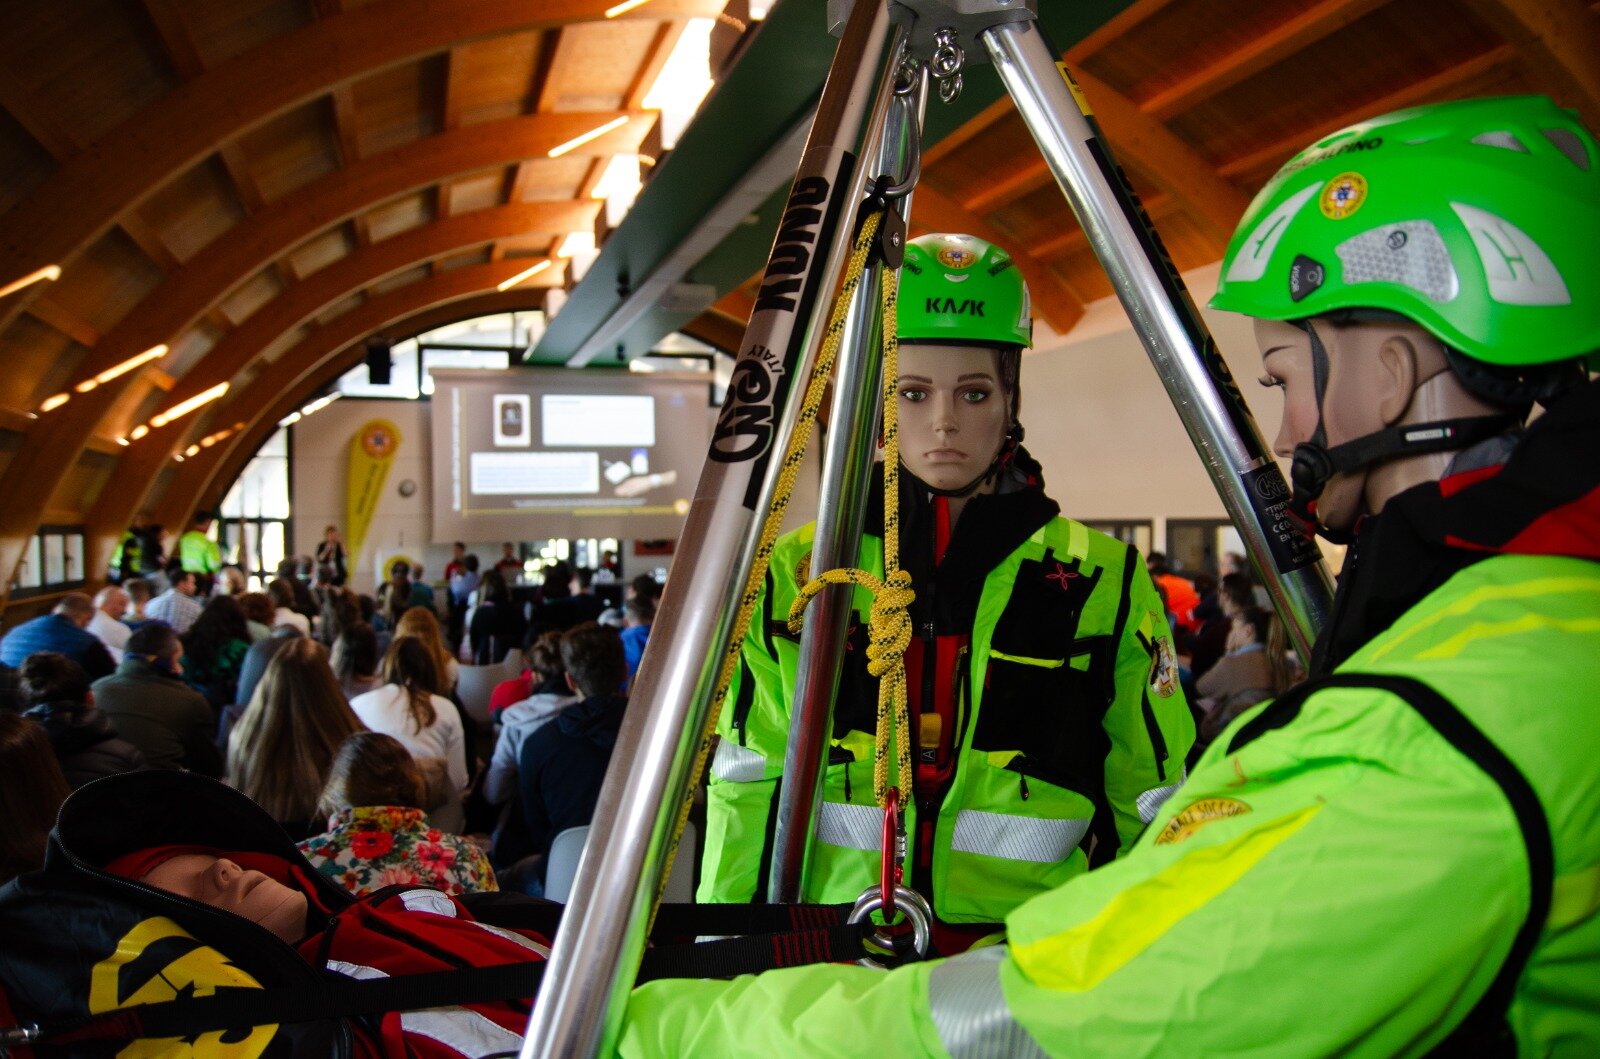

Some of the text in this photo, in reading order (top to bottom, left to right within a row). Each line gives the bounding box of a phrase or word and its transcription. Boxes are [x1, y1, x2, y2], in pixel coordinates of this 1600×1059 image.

[753, 175, 831, 314] KONG
[925, 297, 986, 317] KASK
[747, 343, 785, 375] ITALY
